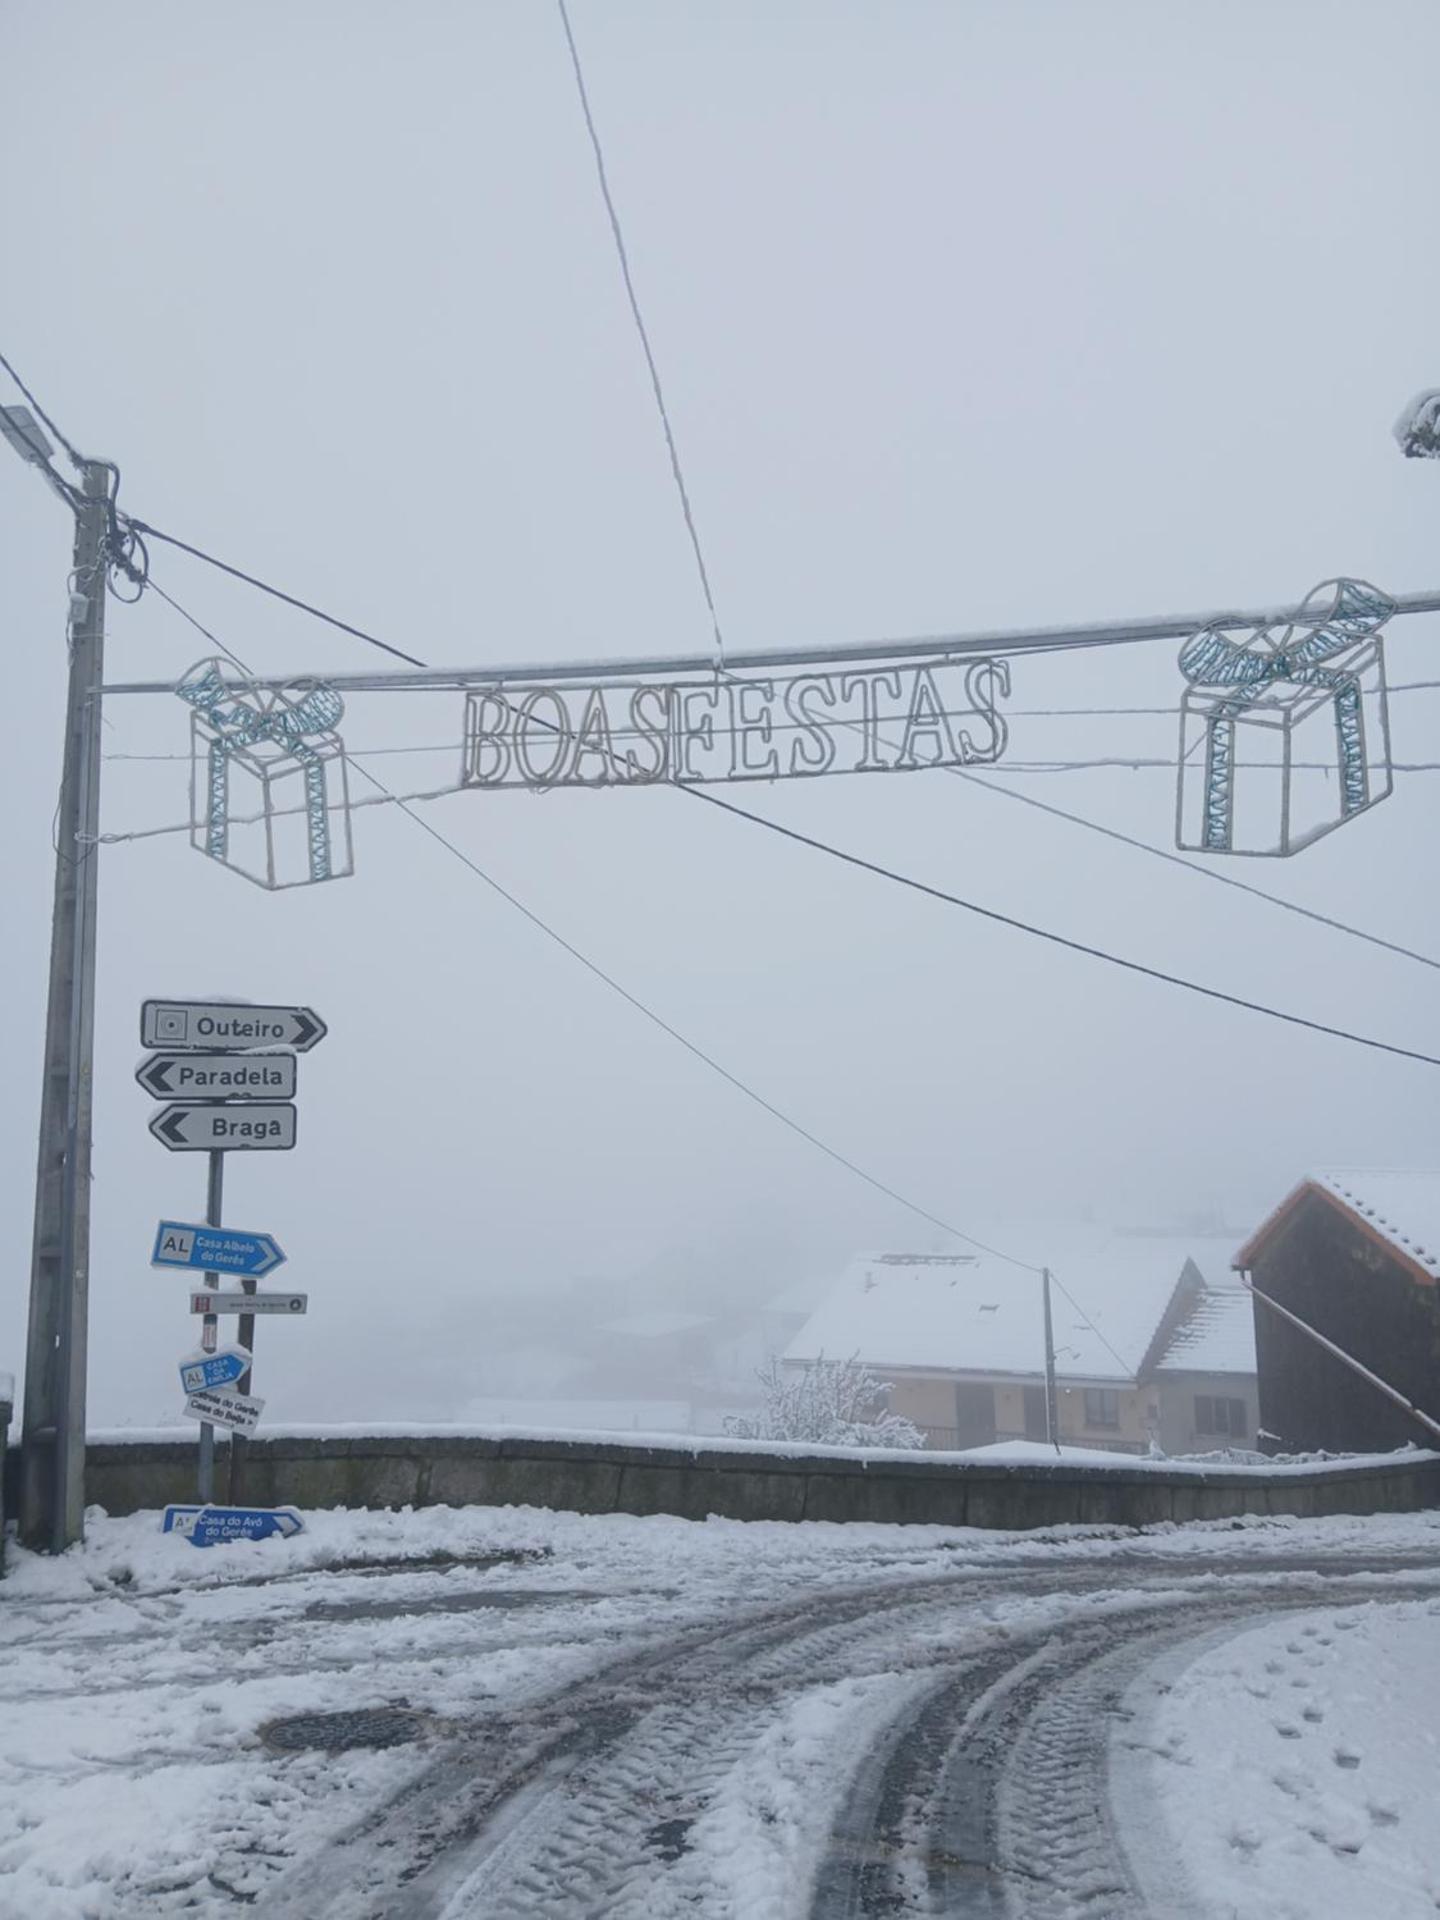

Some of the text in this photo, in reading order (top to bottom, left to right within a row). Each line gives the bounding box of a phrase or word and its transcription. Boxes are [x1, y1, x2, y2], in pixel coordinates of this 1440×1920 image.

[197, 1017, 284, 1038] Outeiro
[179, 1067, 283, 1085] Paradela
[212, 1118, 281, 1140] Braga
[163, 1236, 189, 1253] AL
[196, 1237, 222, 1249] Casa
[201, 1251, 214, 1261] do
[187, 1371, 204, 1385] AL
[191, 1400, 211, 1413] Casa
[213, 1408, 224, 1417] do
[227, 1515, 241, 1526] do
[205, 1526, 220, 1536] do
